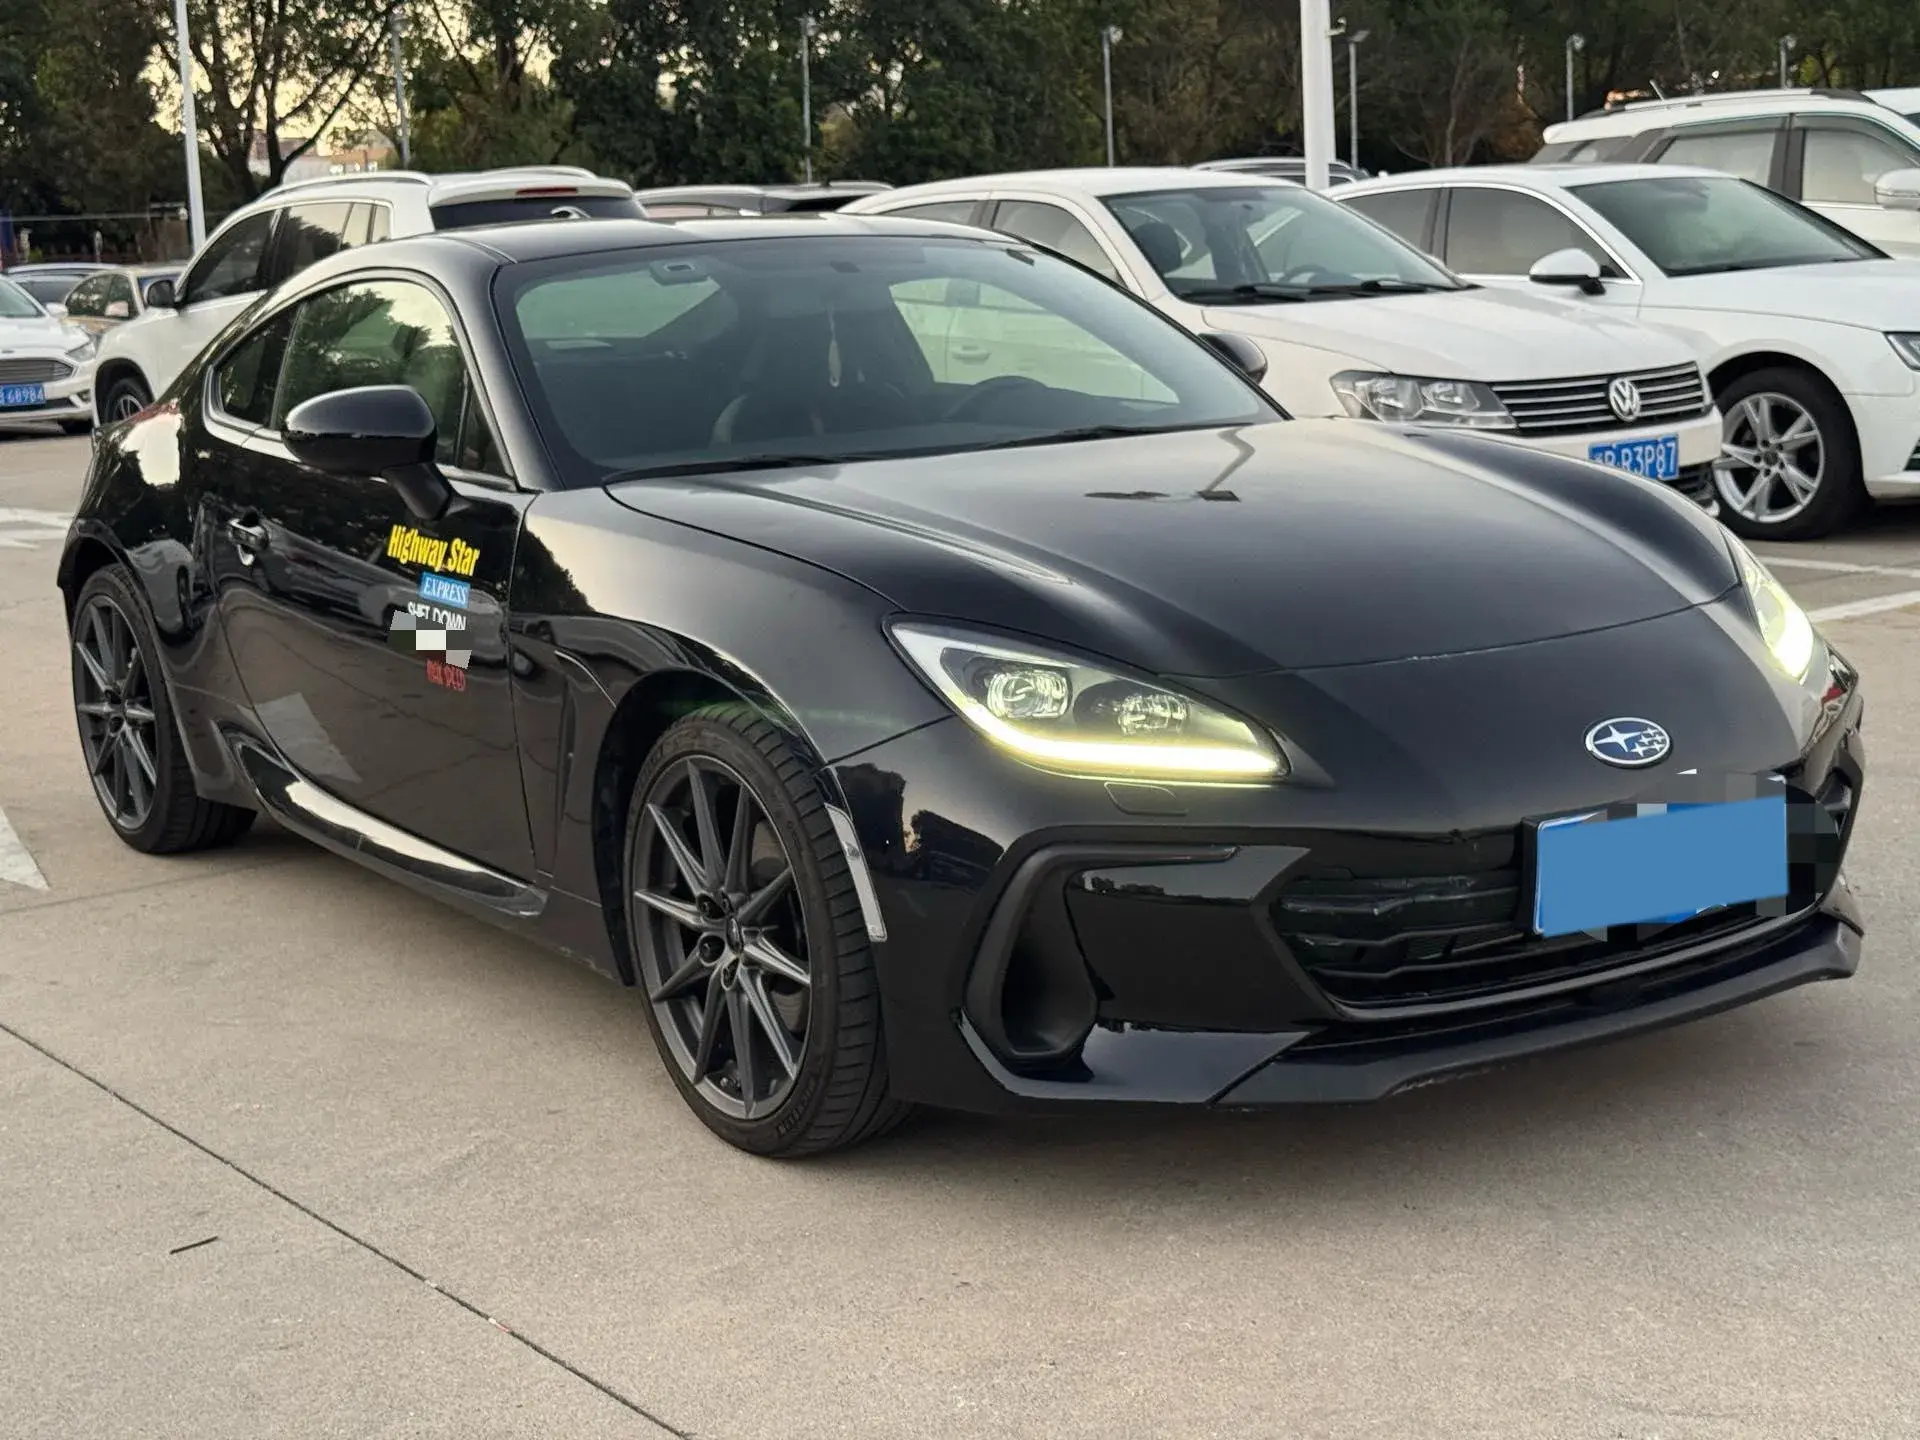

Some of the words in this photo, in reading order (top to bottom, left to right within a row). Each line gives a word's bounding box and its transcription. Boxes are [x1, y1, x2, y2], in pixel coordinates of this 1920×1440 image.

[1593, 442, 1676, 475] R3P87
[387, 524, 448, 572] Highway
[447, 537, 480, 576] Star
[423, 576, 468, 604] EXPRESS
